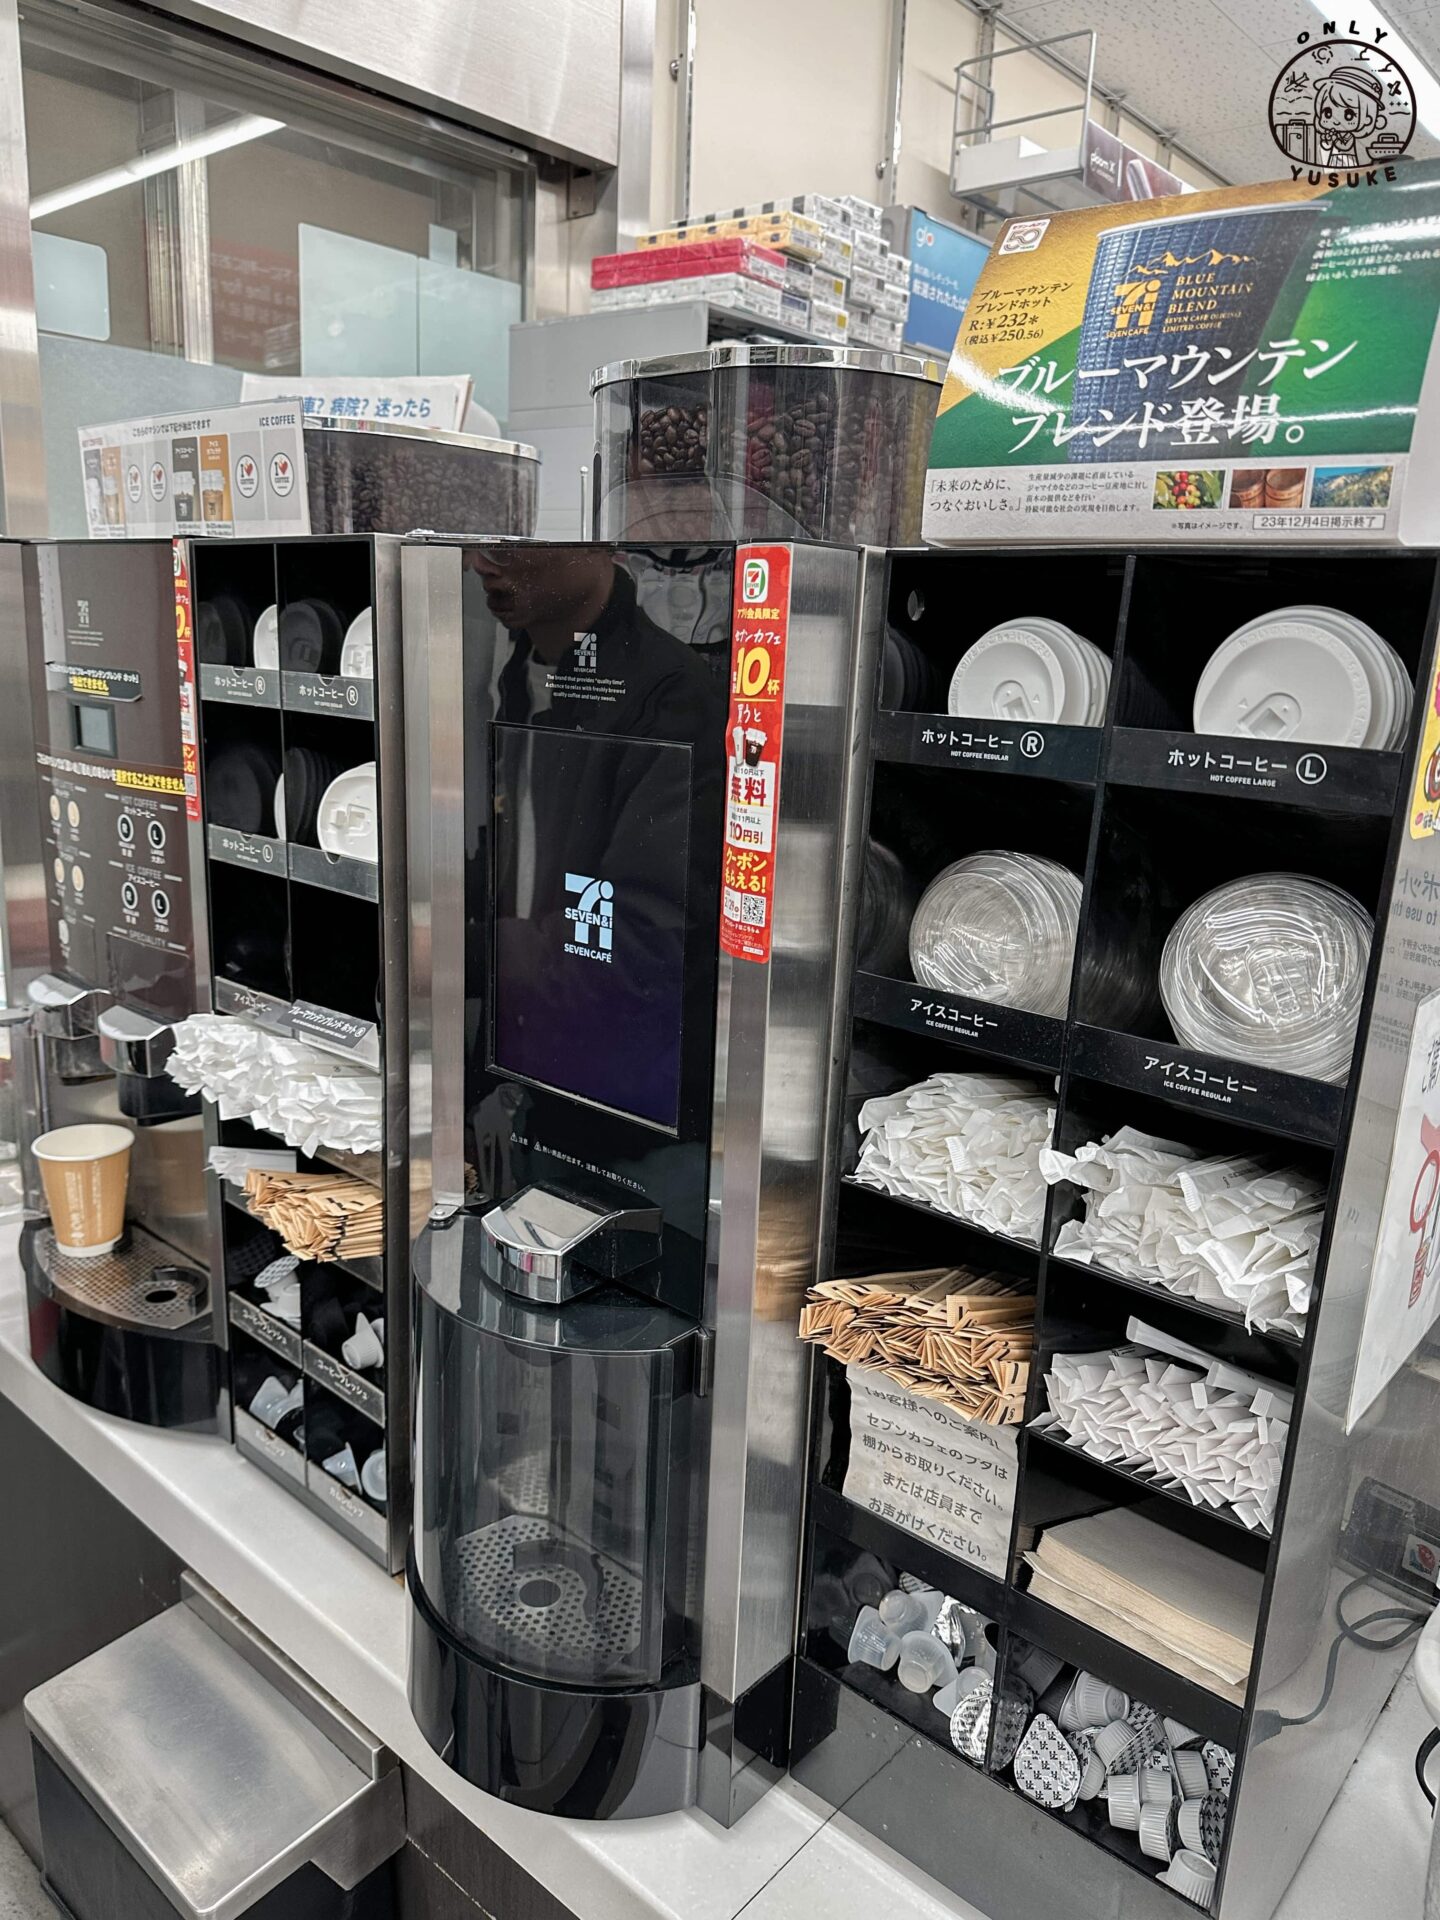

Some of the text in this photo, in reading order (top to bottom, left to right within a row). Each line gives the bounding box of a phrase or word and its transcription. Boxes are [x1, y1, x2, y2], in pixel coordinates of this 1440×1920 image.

[1176, 272, 1216, 287] BLUE
[980, 282, 1074, 301] ブルーマウンテン
[1172, 283, 1254, 301] MOUNTAIN
[975, 296, 1052, 315] ブレンドホット
[1168, 300, 1218, 315] BLEND
[998, 339, 1359, 397] ブルーマウンテン
[330, 396, 369, 416] 病院?
[375, 397, 430, 418] 迷ったら
[259, 414, 296, 427] ICE COFFEE
[1260, 516, 1376, 529] 23年12月4日掲示終了
[214, 676, 253, 689] ホットコーヒー
[299, 685, 345, 699] ホットコーヒー
[921, 728, 1014, 751] ホットコーヒー
[950, 750, 1009, 761] HOT COFFEE REGULAR
[1168, 749, 1288, 773] ホットコーヒー
[731, 773, 767, 808] 無料
[1210, 774, 1276, 788] HOT COFFEE LARGE
[725, 846, 768, 873] クーポン
[724, 867, 767, 894] もらえる!
[910, 998, 998, 1029] アイスコーヒー
[925, 1019, 979, 1038] ICE COFFEE REGULAR
[1144, 1056, 1258, 1094] アイスコーヒー
[1175, 1083, 1199, 1096] COFFEE
[1201, 1088, 1232, 1103] REGULAR
[862, 1434, 1004, 1511] 棚からお取りください。
[883, 1471, 983, 1525] または店員まで
[868, 1497, 987, 1562] お声がけください。
